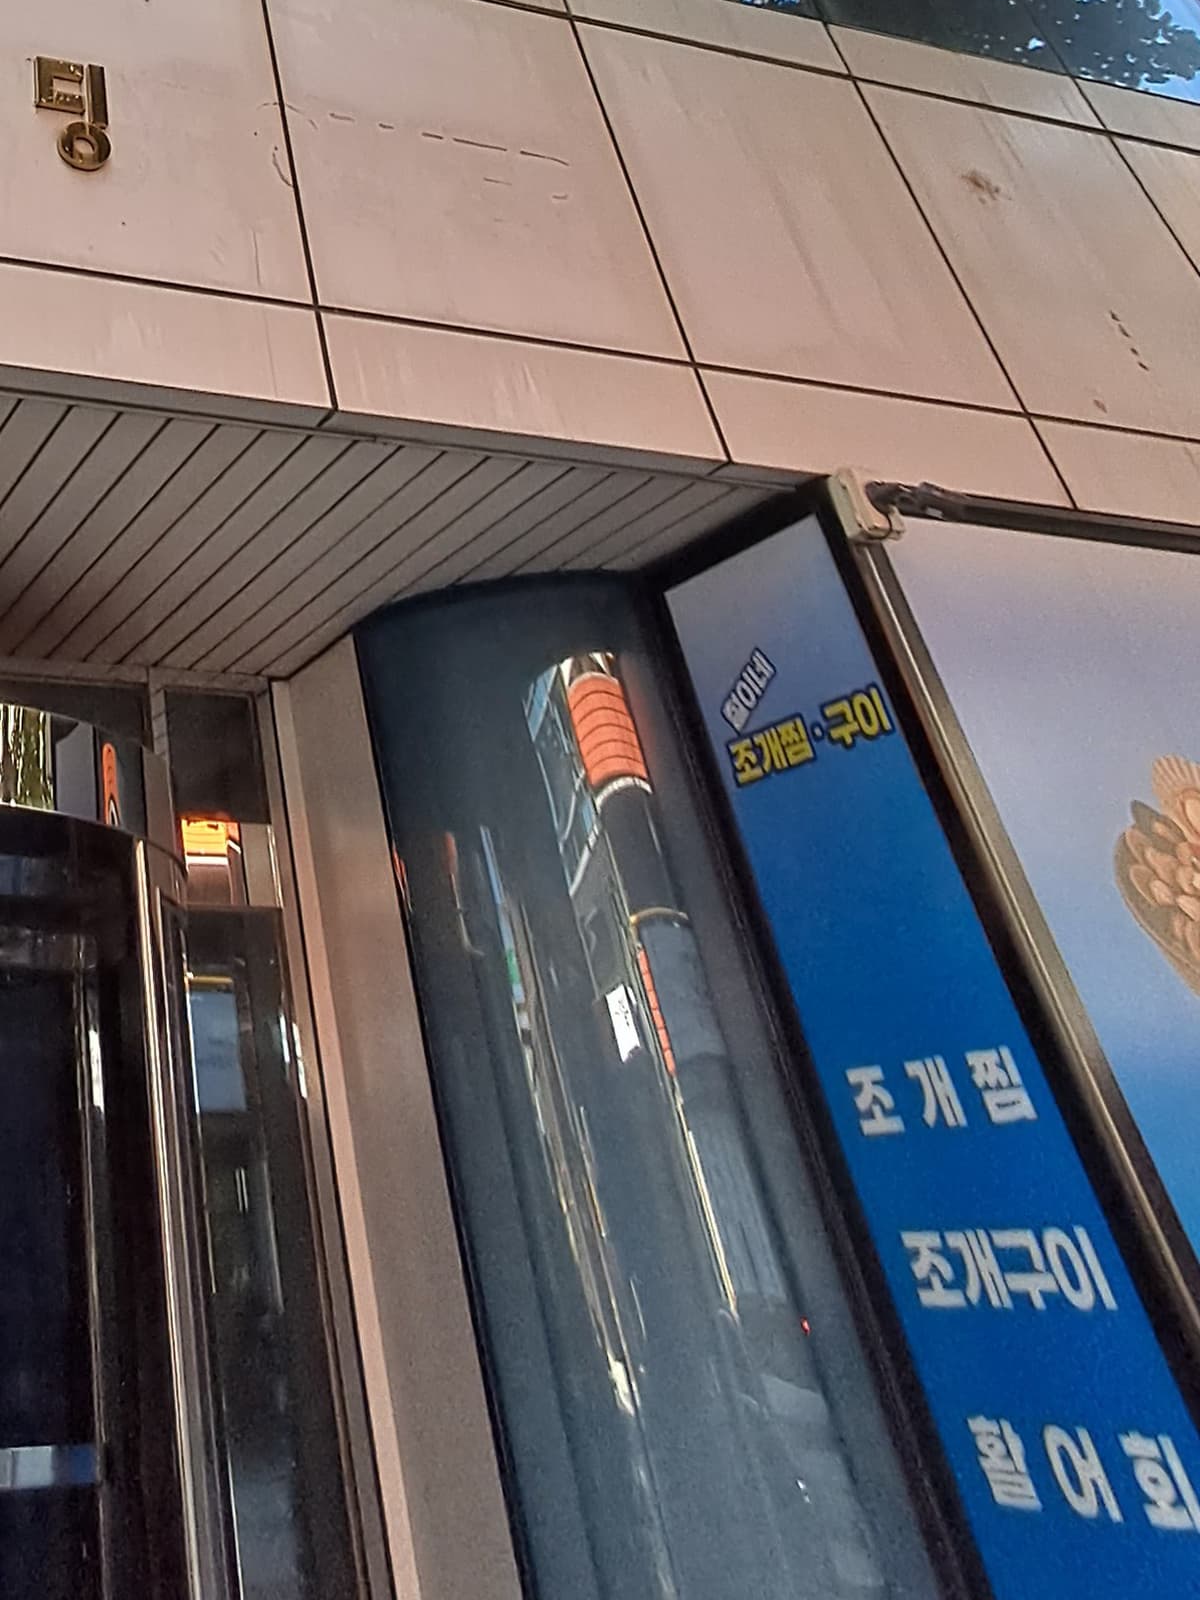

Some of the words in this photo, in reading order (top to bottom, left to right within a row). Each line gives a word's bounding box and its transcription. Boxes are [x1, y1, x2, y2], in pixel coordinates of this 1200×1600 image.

[845, 1045, 1038, 1137] 조개찜
[901, 1226, 1118, 1312] 조개구이
[966, 1414, 1200, 1532] 활어회
